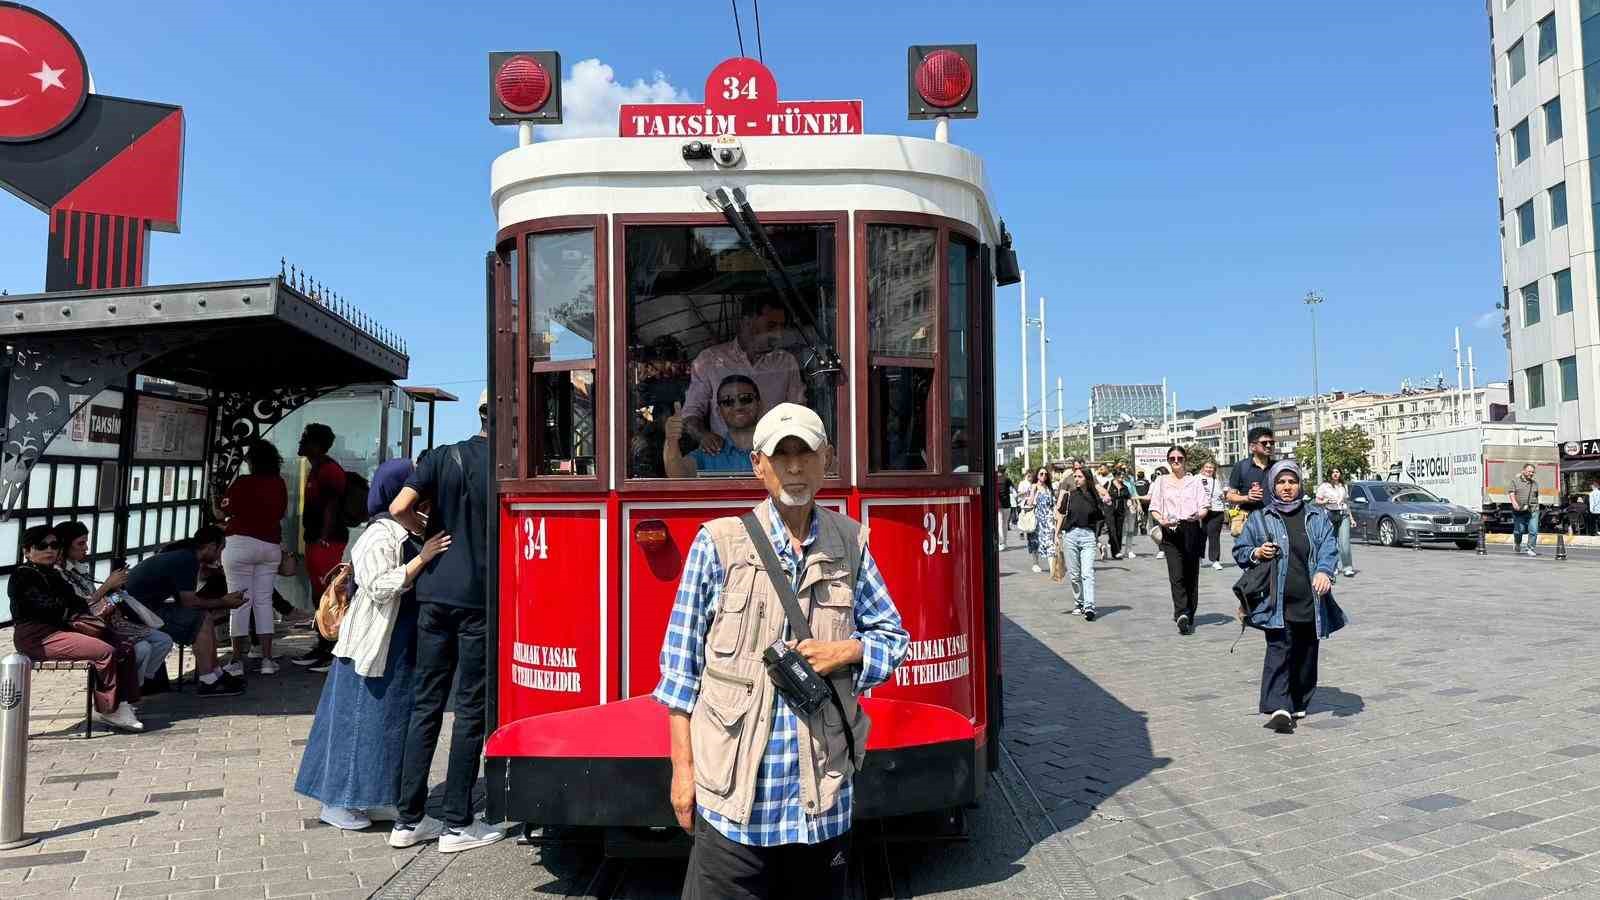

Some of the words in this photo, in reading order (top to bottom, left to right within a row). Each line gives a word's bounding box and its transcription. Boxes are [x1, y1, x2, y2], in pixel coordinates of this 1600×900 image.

[722, 76, 758, 100] 34
[632, 109, 737, 136] TAKSİM
[767, 108, 854, 135] TÜNEL
[91, 414, 121, 434] TAKSİM
[524, 517, 548, 560] 34
[922, 512, 950, 556] 34
[541, 646, 577, 668] YASAK
[907, 638, 946, 662] SILMAK
[894, 665, 911, 687] VE
